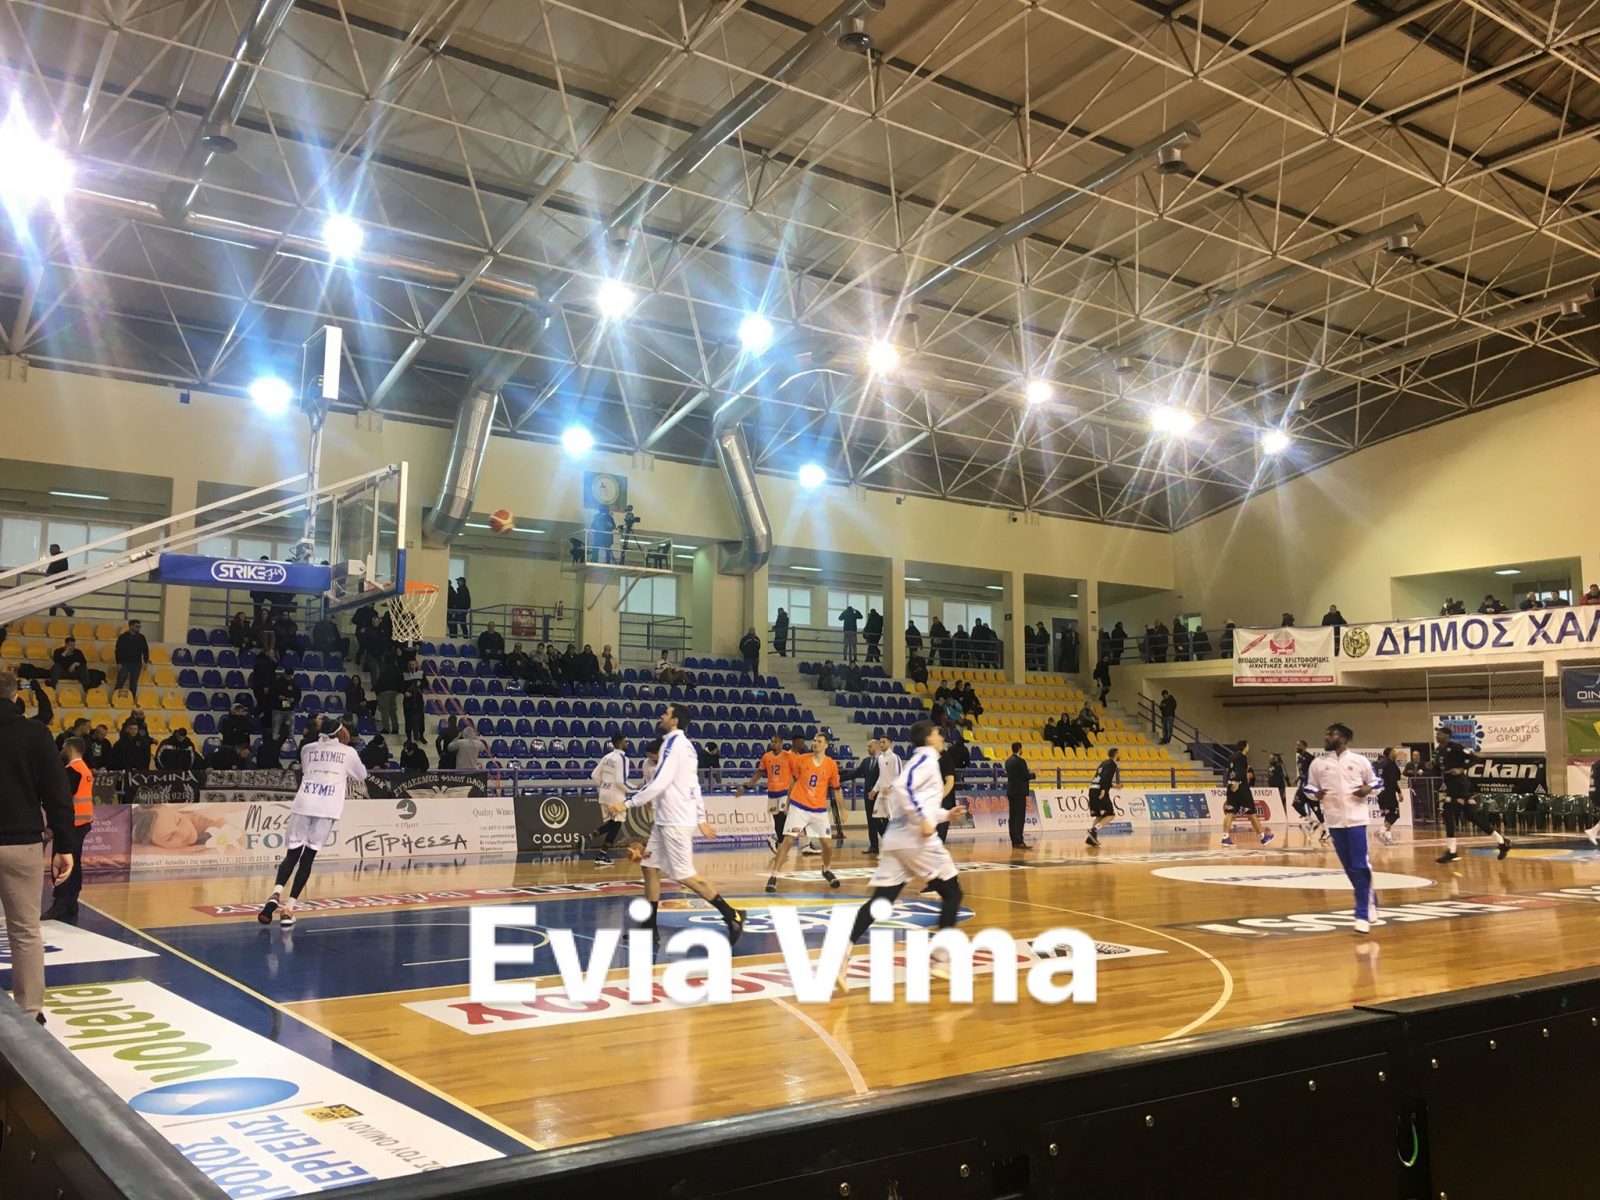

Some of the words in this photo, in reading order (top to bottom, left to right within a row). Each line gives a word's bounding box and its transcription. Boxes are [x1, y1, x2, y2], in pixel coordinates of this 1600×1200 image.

[1375, 616, 1514, 656] ΔΗΜΟΣ
[1487, 725, 1540, 735] SAMARTZIS
[1496, 734, 1532, 743] GROUP
[770, 765, 780, 775] 12
[1464, 759, 1539, 779] ckan
[128, 770, 199, 787] KYMINA
[809, 775, 818, 788] 8
[532, 832, 580, 844] COCUS
